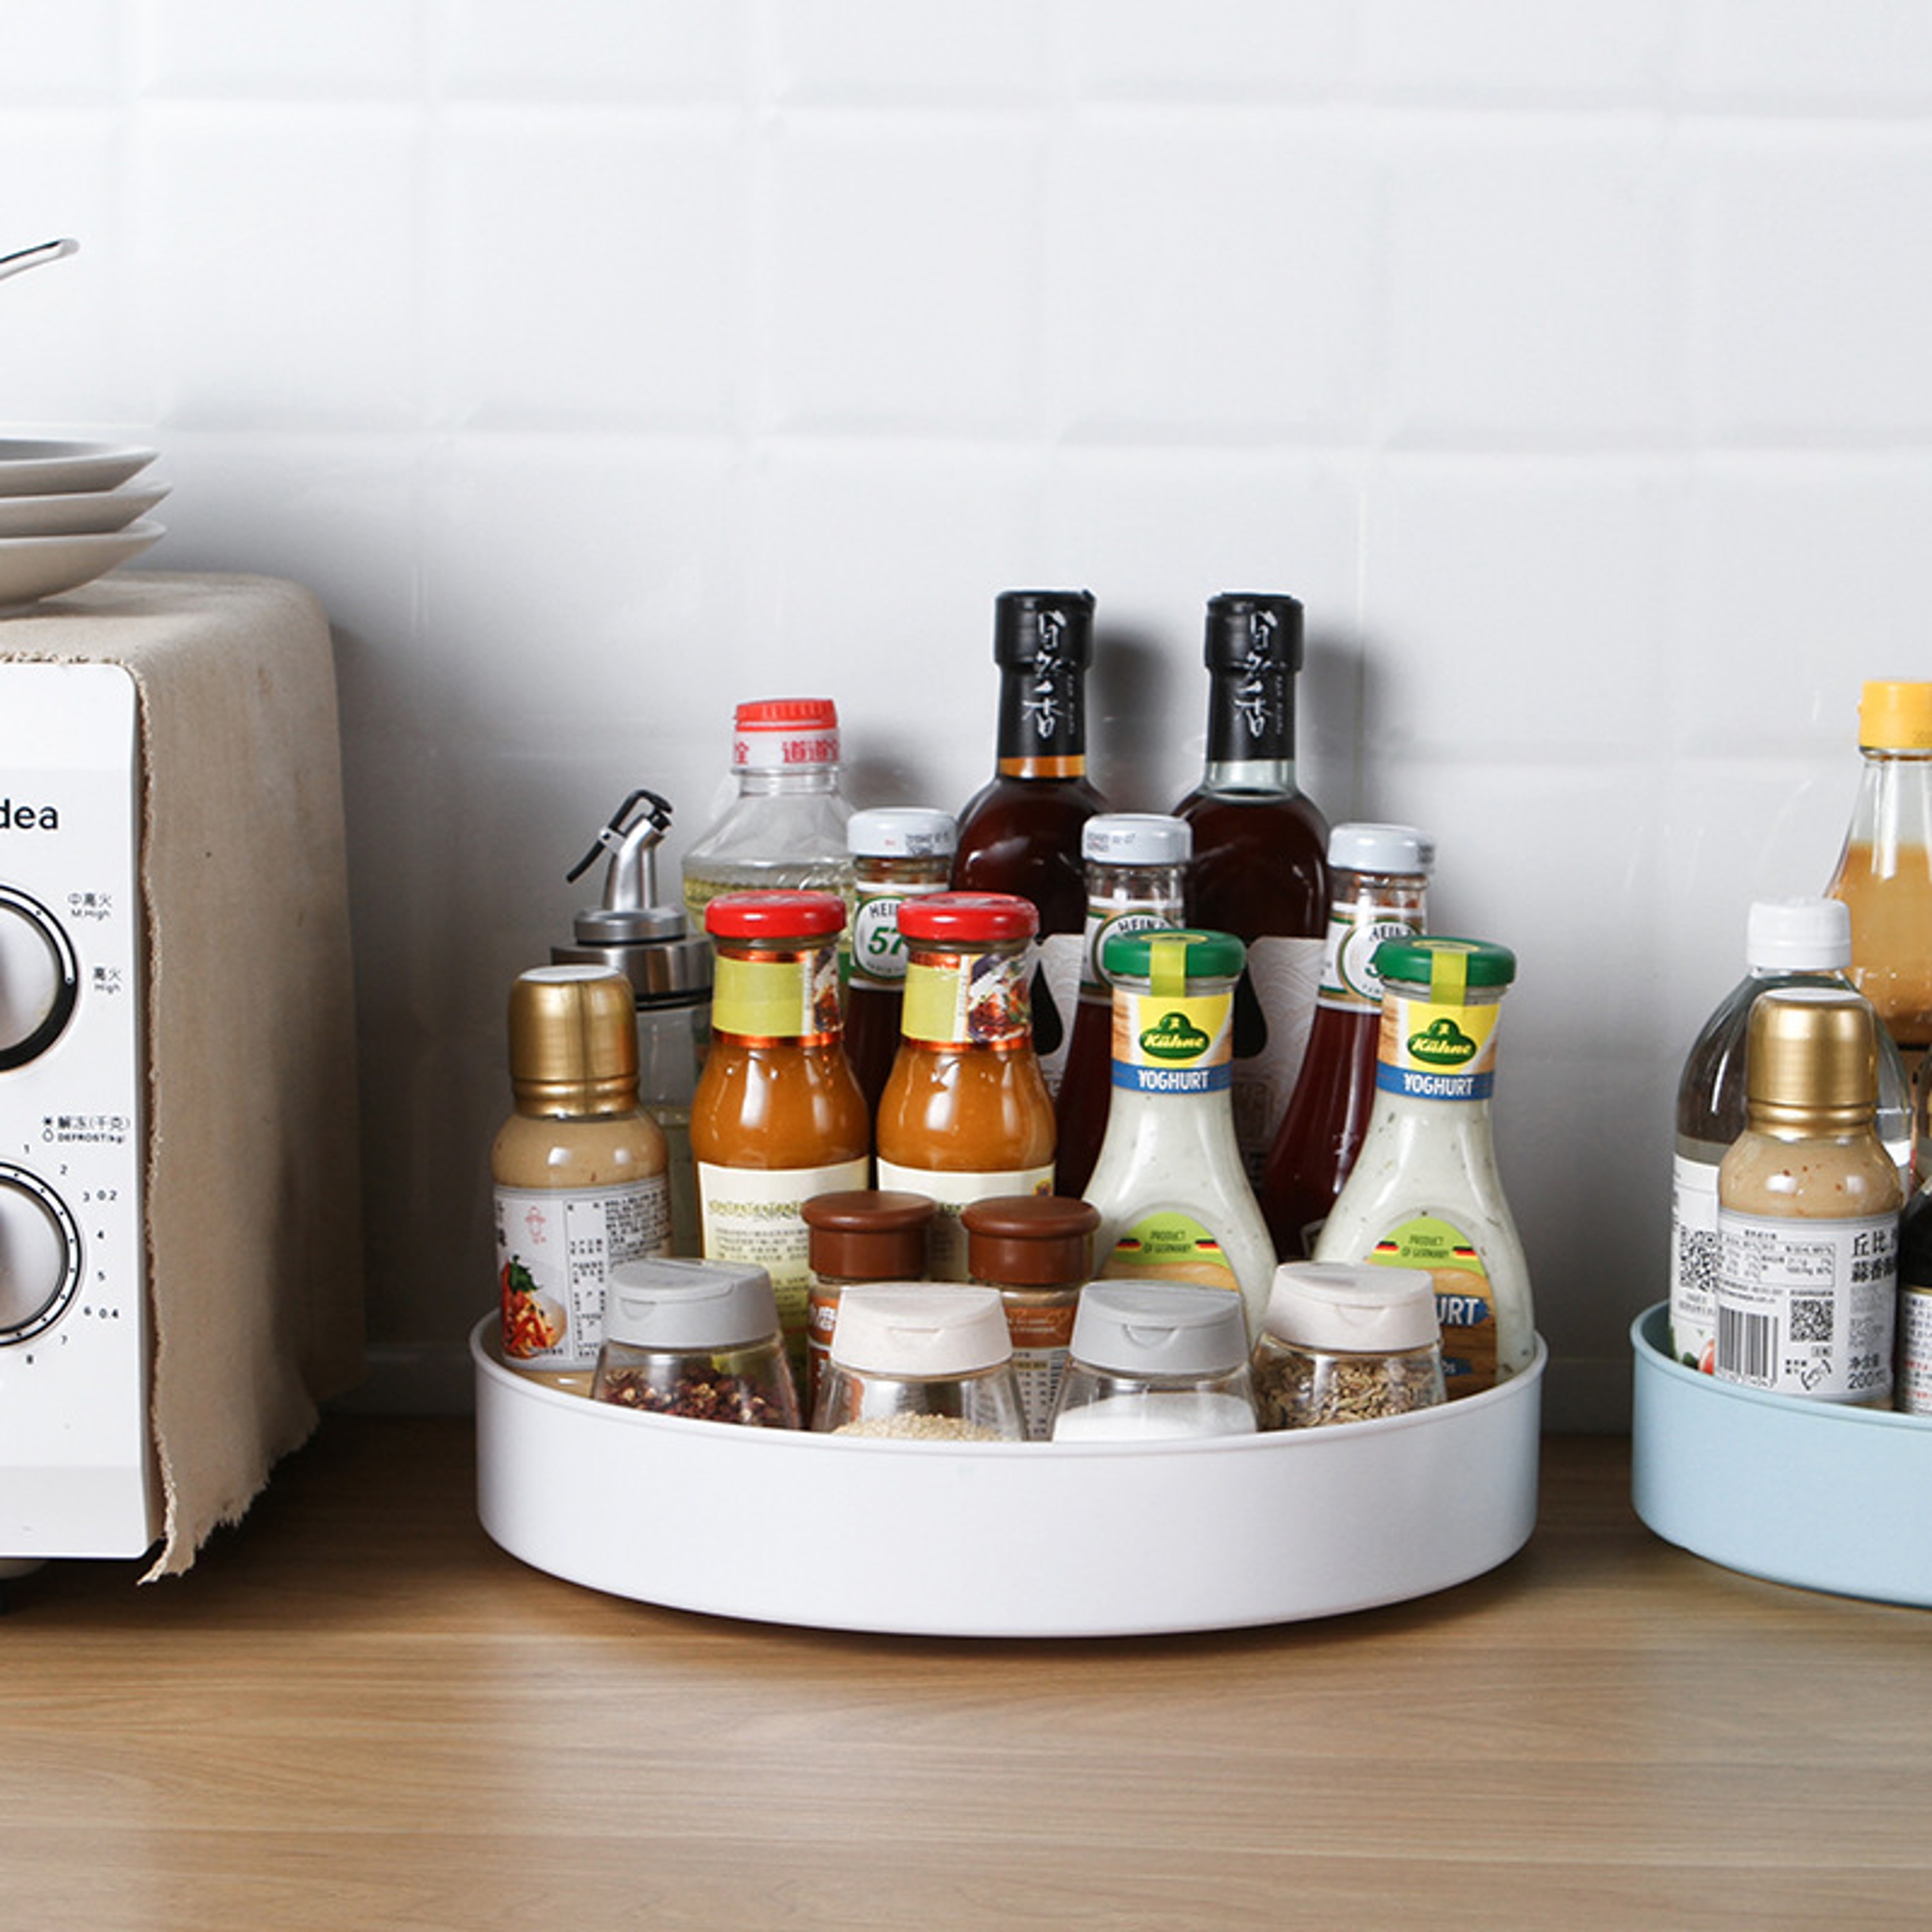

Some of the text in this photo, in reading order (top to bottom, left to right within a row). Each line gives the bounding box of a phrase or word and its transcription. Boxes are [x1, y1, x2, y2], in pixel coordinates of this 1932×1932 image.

[868, 926, 905, 955] 57
[1144, 1032, 1205, 1048] Kühne
[1412, 1036, 1472, 1054] Kühne
[1137, 1069, 1211, 1090] YOGHURT
[1403, 1073, 1474, 1096] YOGHURT
[59, 1164, 68, 1175] 2
